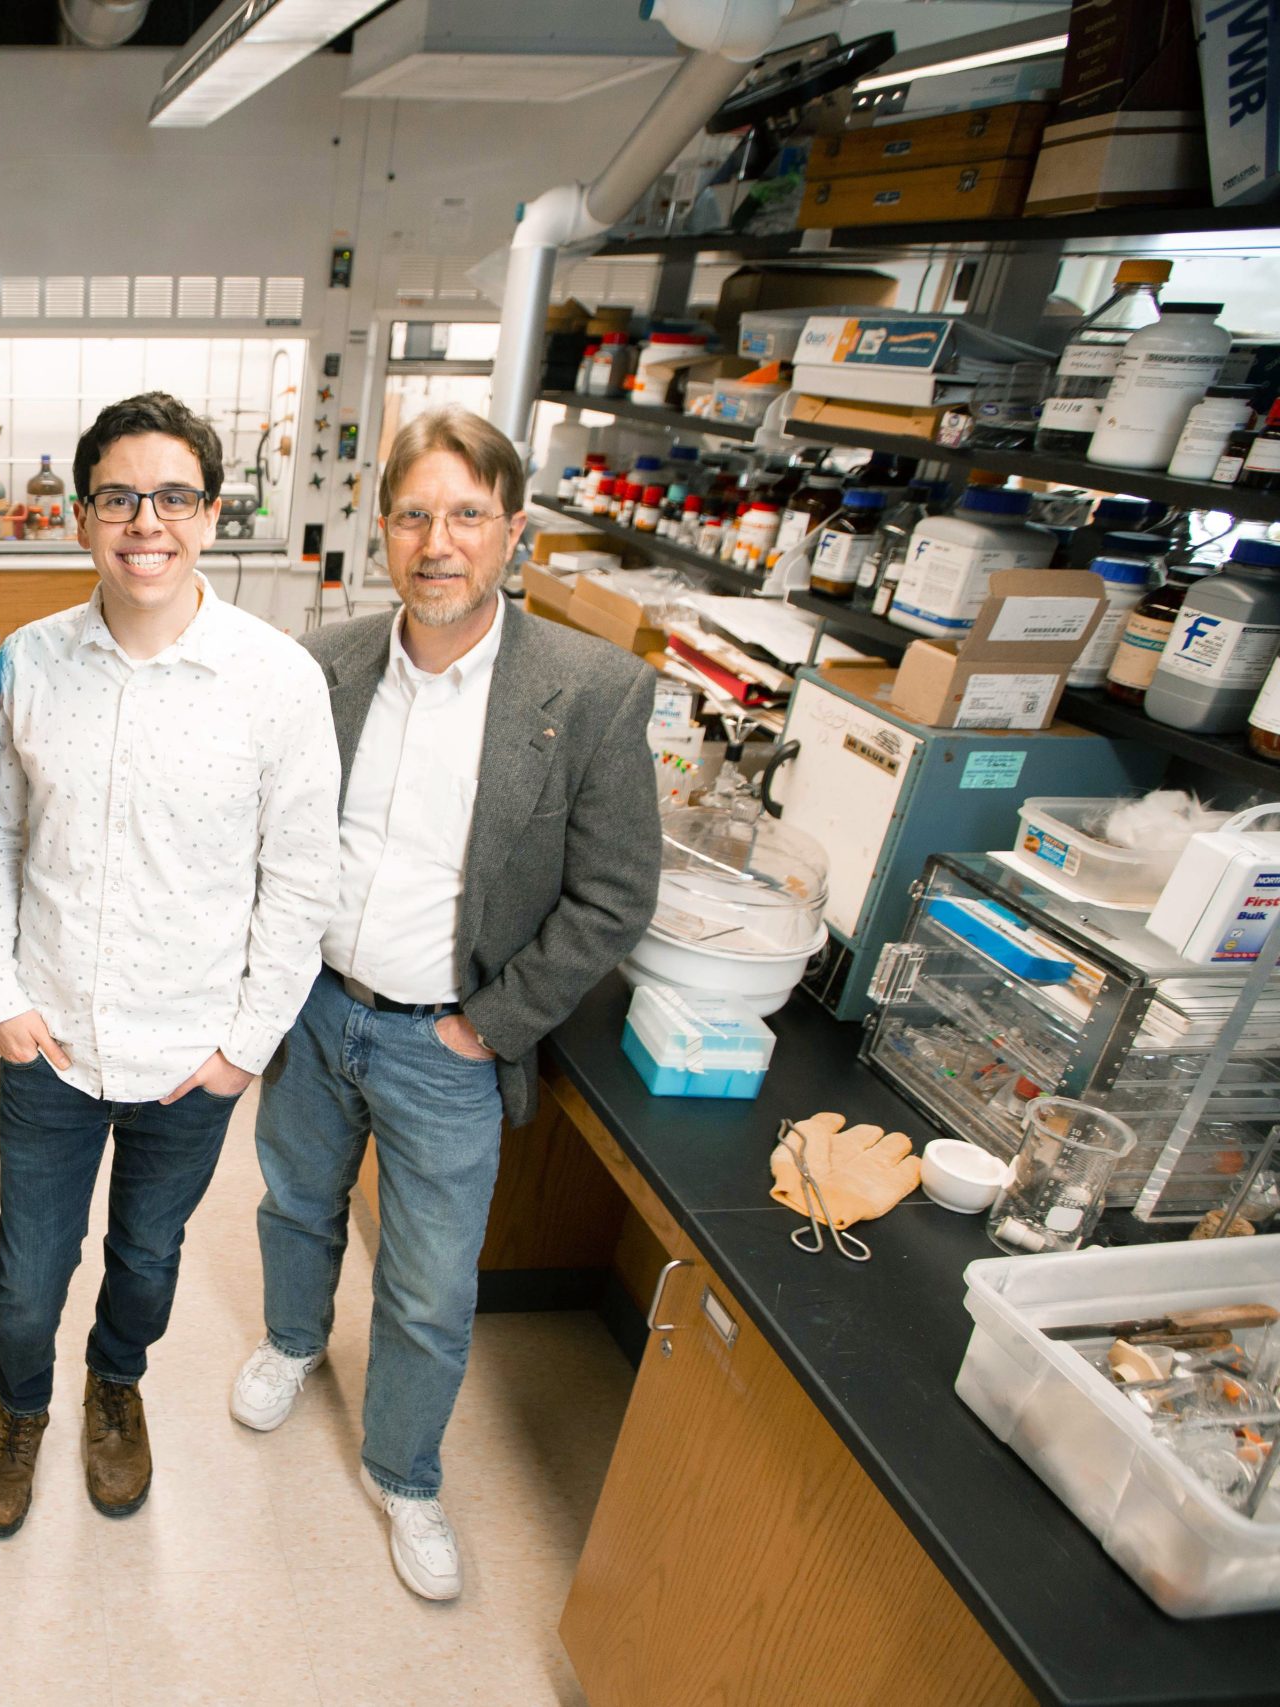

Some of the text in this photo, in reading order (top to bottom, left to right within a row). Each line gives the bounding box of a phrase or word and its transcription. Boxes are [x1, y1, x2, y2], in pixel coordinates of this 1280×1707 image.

[1227, 0, 1269, 128] VWR
[1148, 354, 1185, 364] Storage
[1188, 355, 1210, 363] Code
[818, 534, 837, 557] F
[916, 541, 930, 561] F
[1182, 616, 1221, 650] F
[860, 747, 885, 763] BLUE
[1244, 896, 1280, 906] First
[1237, 912, 1268, 920] Bulk
